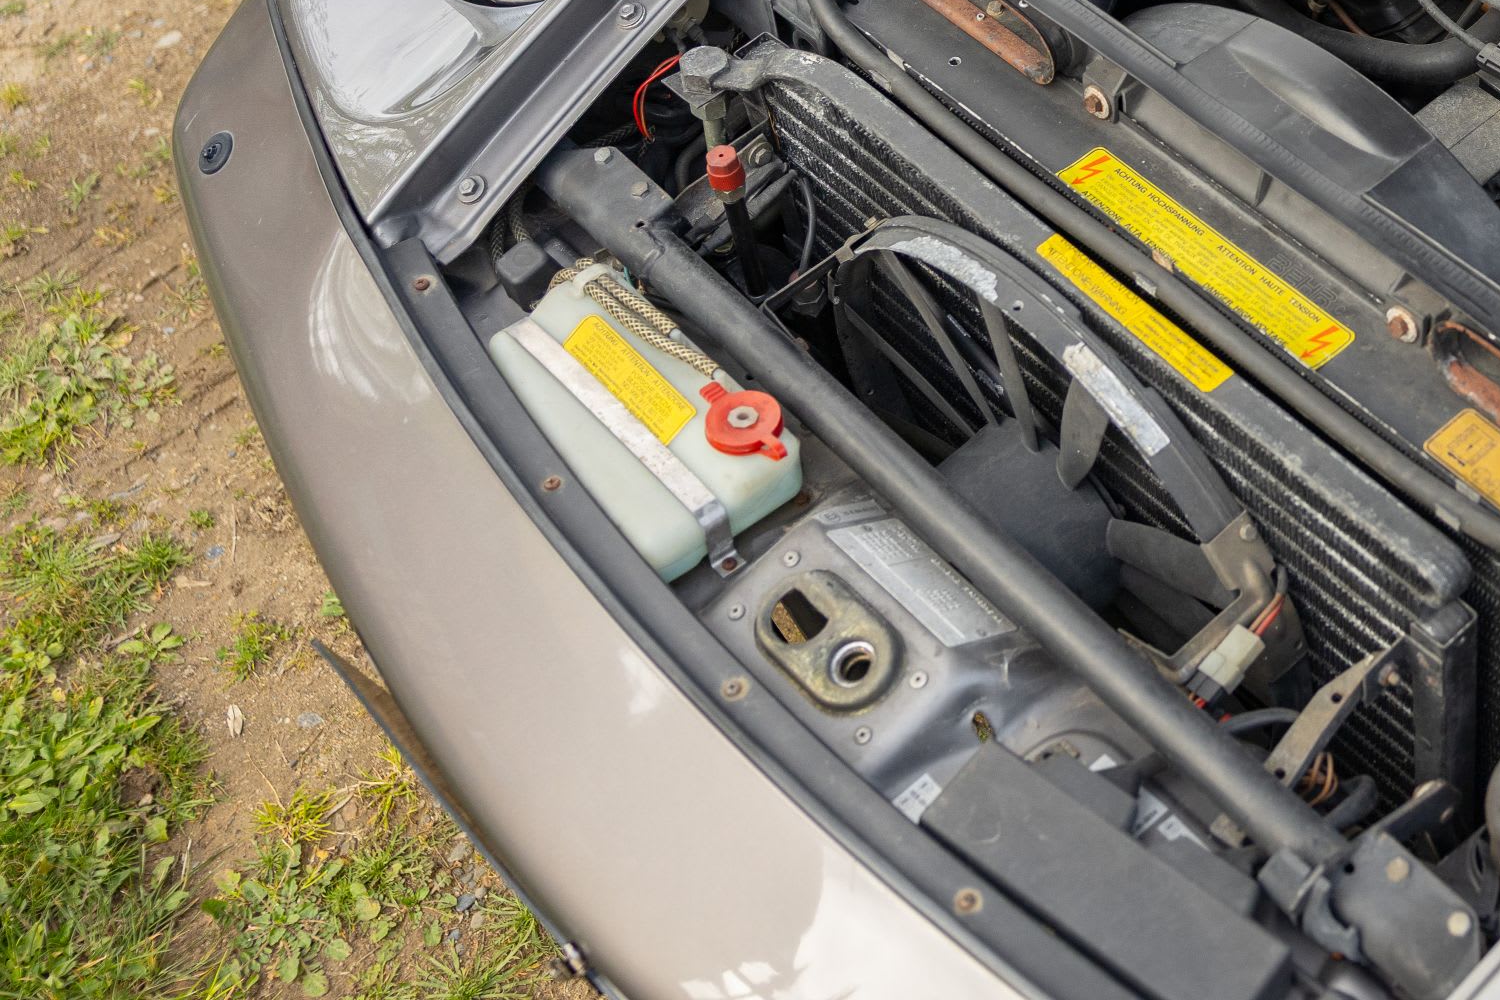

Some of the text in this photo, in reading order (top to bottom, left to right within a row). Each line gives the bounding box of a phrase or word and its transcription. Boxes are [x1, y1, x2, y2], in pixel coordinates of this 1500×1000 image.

[1080, 189, 1124, 222] ATTENZIONE
[1123, 221, 1144, 237] ALTA
[1112, 167, 1148, 193] ACHTUNG
[1146, 192, 1206, 236] HOCHSPANNUNG
[1215, 243, 1258, 276] ATTENTION
[1258, 275, 1285, 296] HAUTE
[1287, 296, 1322, 323] TENSION
